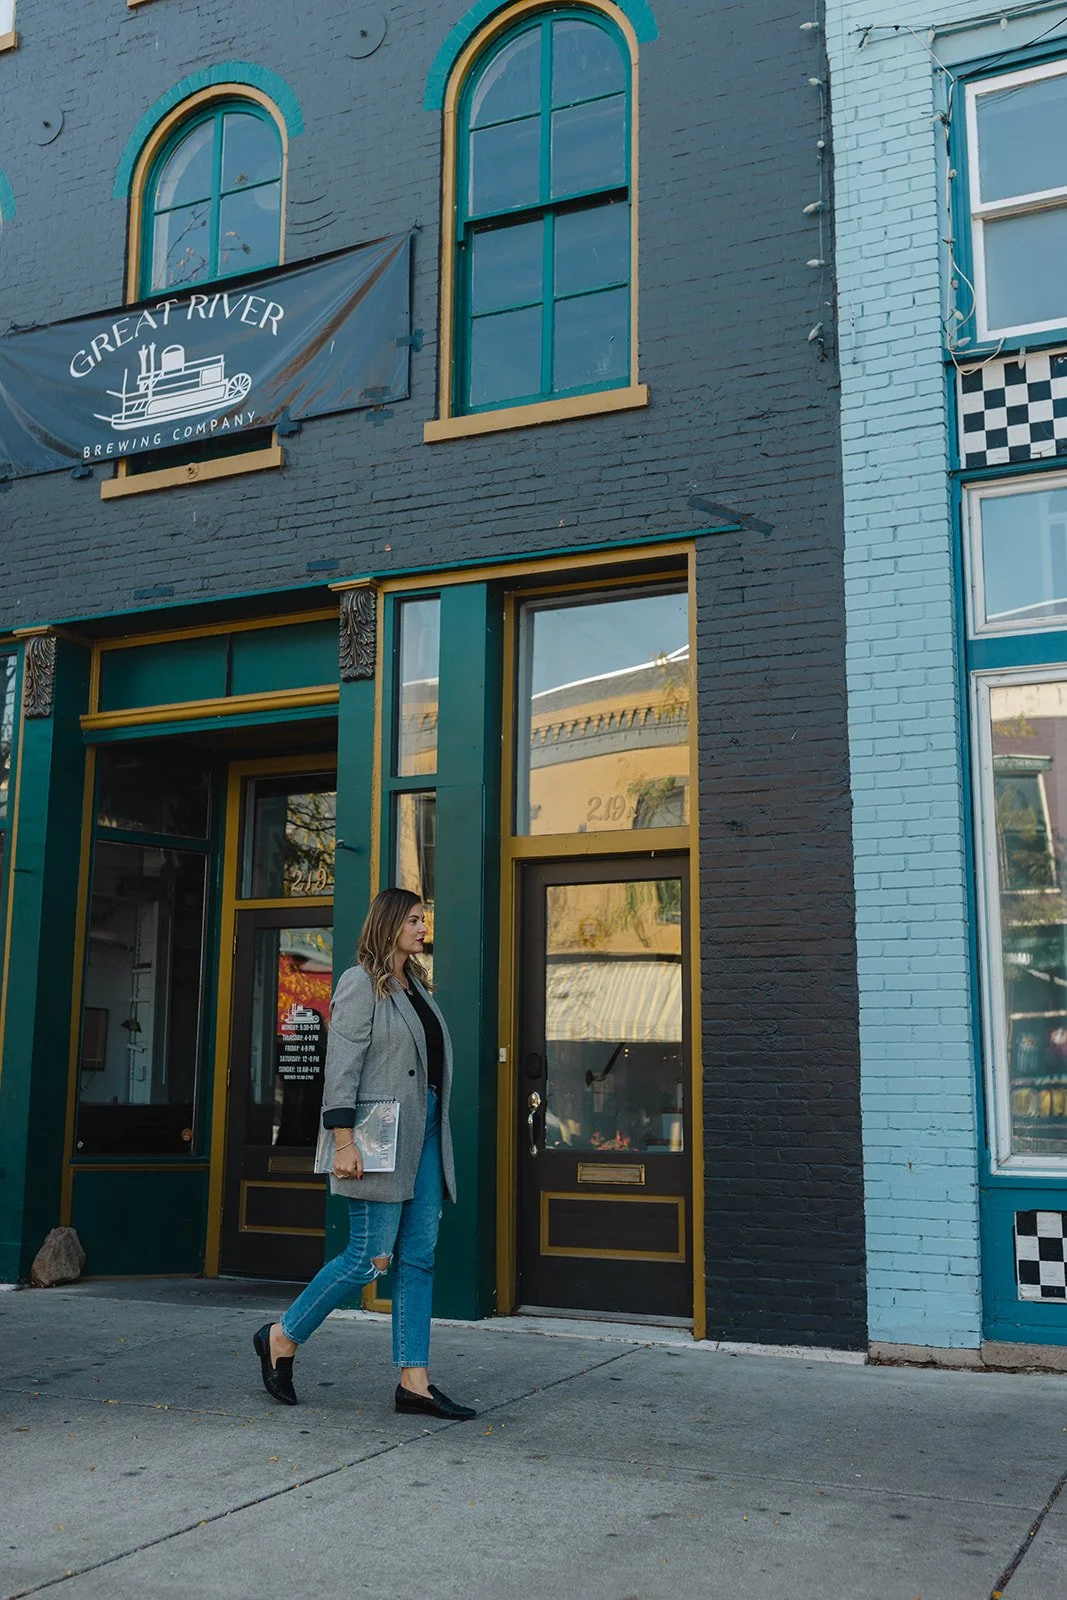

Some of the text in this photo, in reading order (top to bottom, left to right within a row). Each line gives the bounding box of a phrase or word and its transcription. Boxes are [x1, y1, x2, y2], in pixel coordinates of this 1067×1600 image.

[69, 293, 285, 379] GREAT RIVER
[83, 410, 256, 459] BREWING COMPANY
[290, 868, 327, 891] 219
